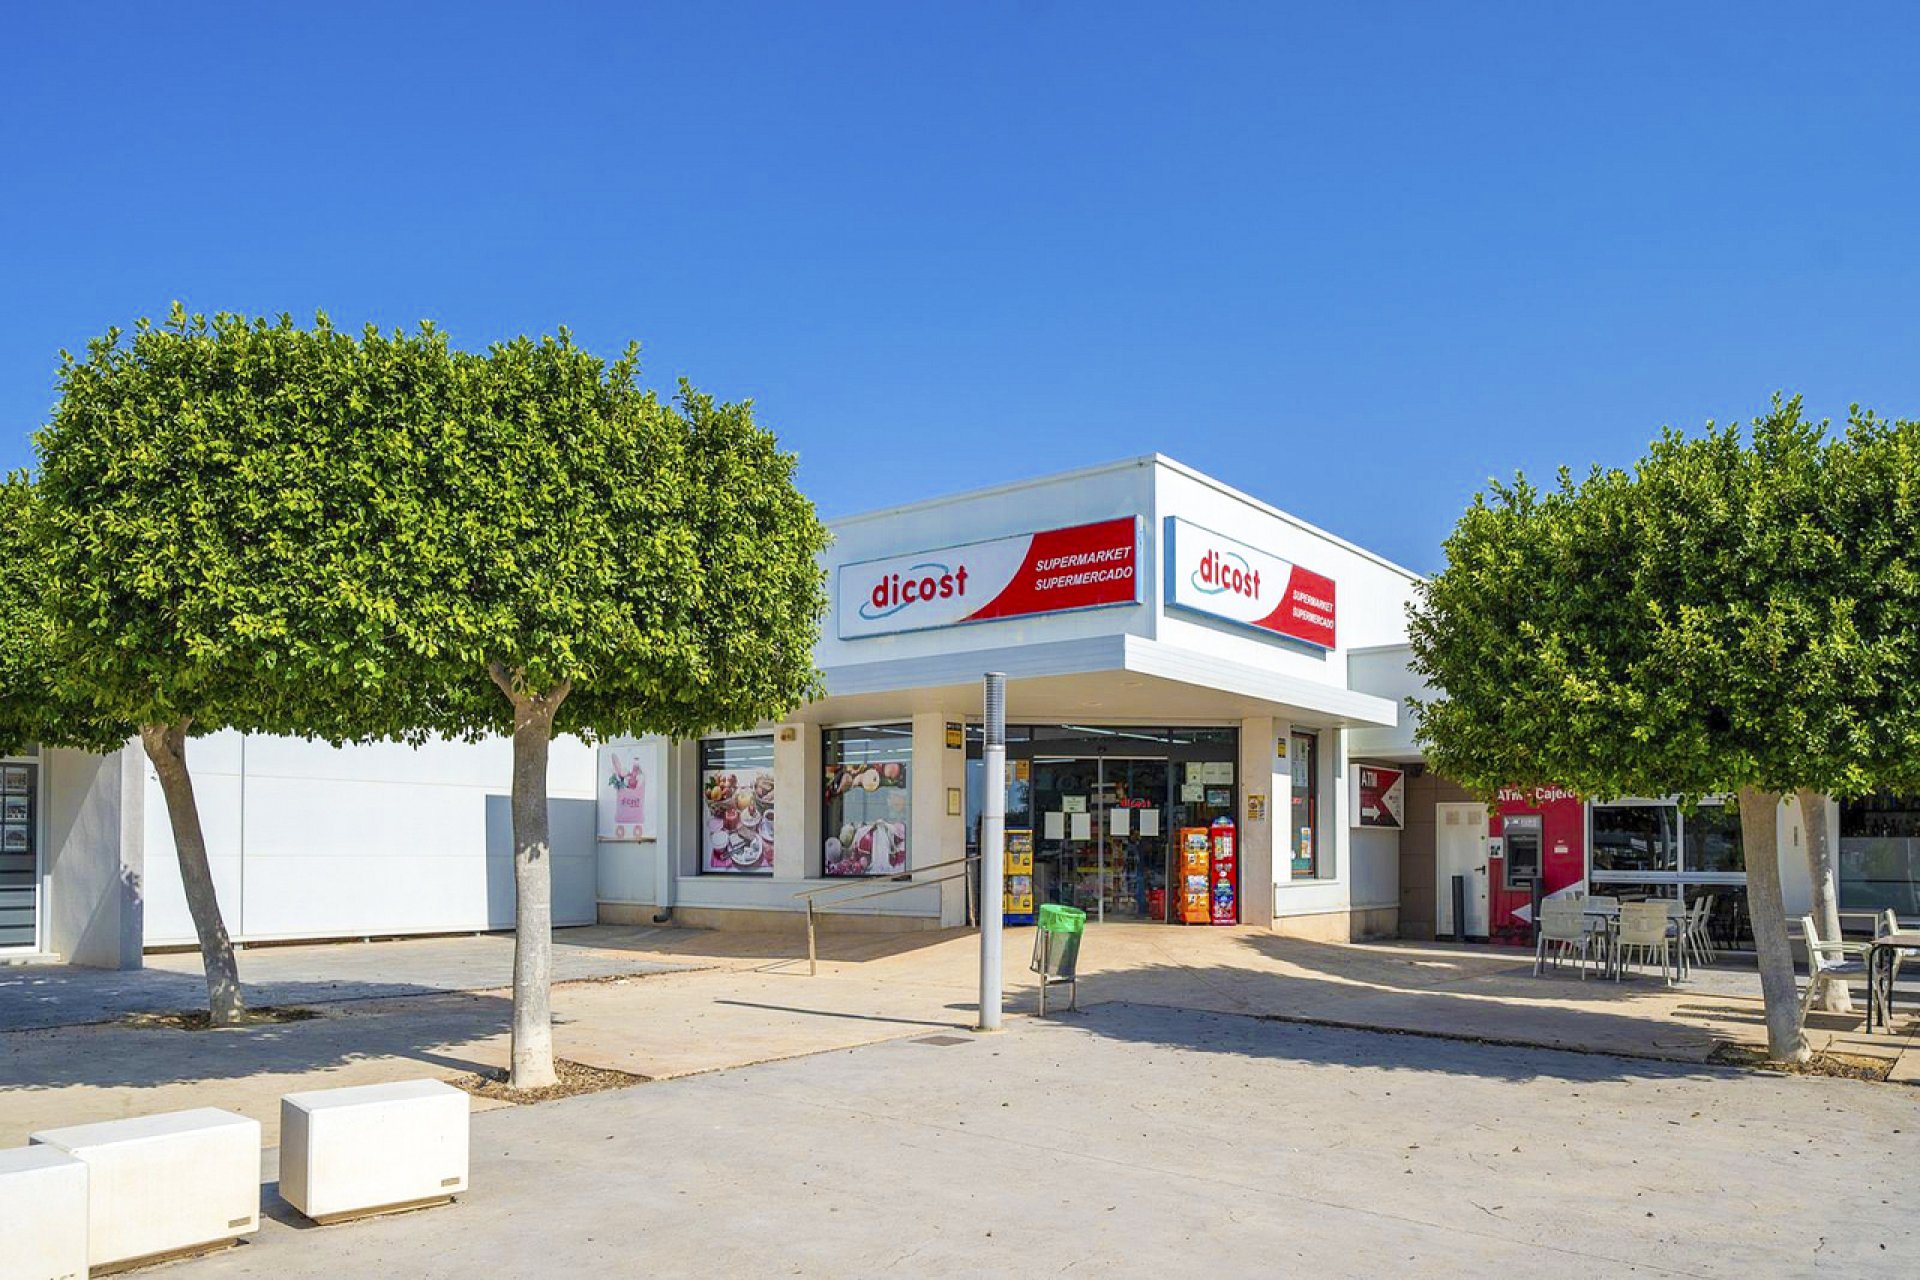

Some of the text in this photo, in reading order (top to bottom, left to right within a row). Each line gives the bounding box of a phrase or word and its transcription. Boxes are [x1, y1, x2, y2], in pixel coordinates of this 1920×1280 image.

[1036, 546, 1132, 572] SUPERMARKET
[872, 565, 968, 608] dicost
[1035, 566, 1133, 591] SUPERMERCADO
[1200, 549, 1260, 600] dicost
[1293, 589, 1333, 613] SUPERMARKET
[1293, 607, 1334, 630] SUPERMERCADO
[1362, 770, 1377, 787] ATM
